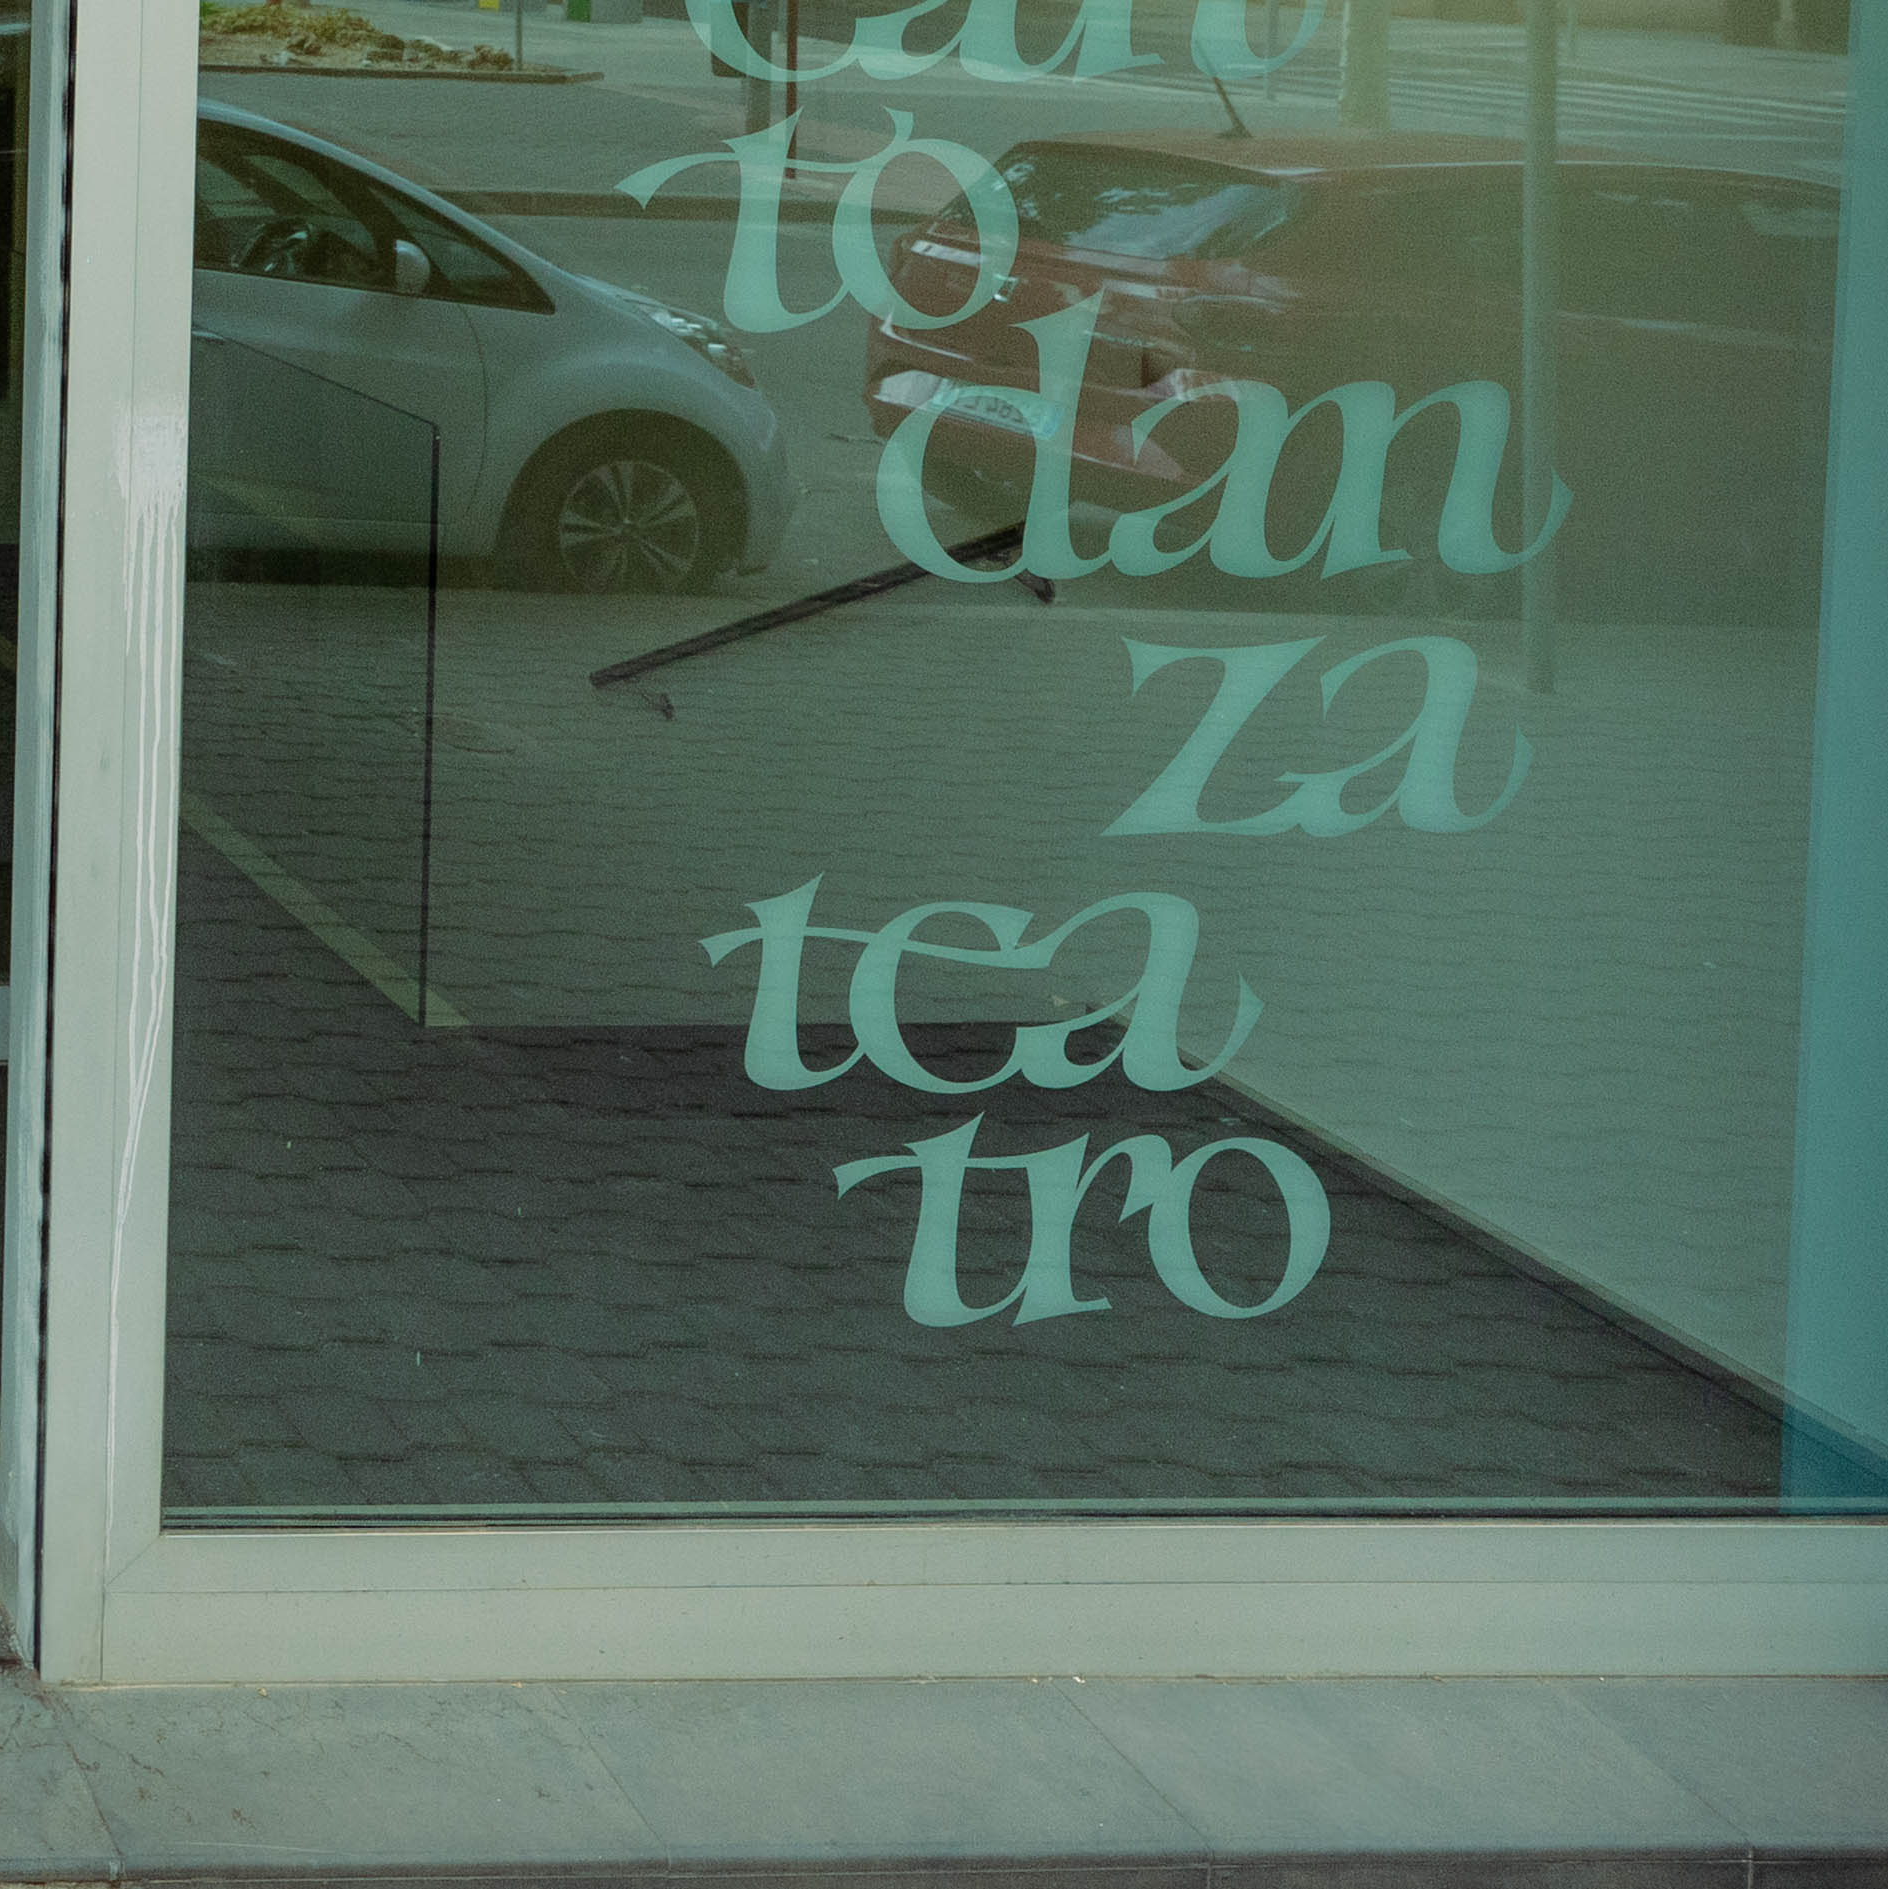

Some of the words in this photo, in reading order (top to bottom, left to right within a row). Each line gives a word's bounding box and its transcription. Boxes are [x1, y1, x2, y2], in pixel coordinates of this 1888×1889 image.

[875, 288, 1575, 583] dan
[1098, 634, 1534, 838] za
[697, 872, 1265, 1094] tea
[831, 1110, 1332, 1328] tro
